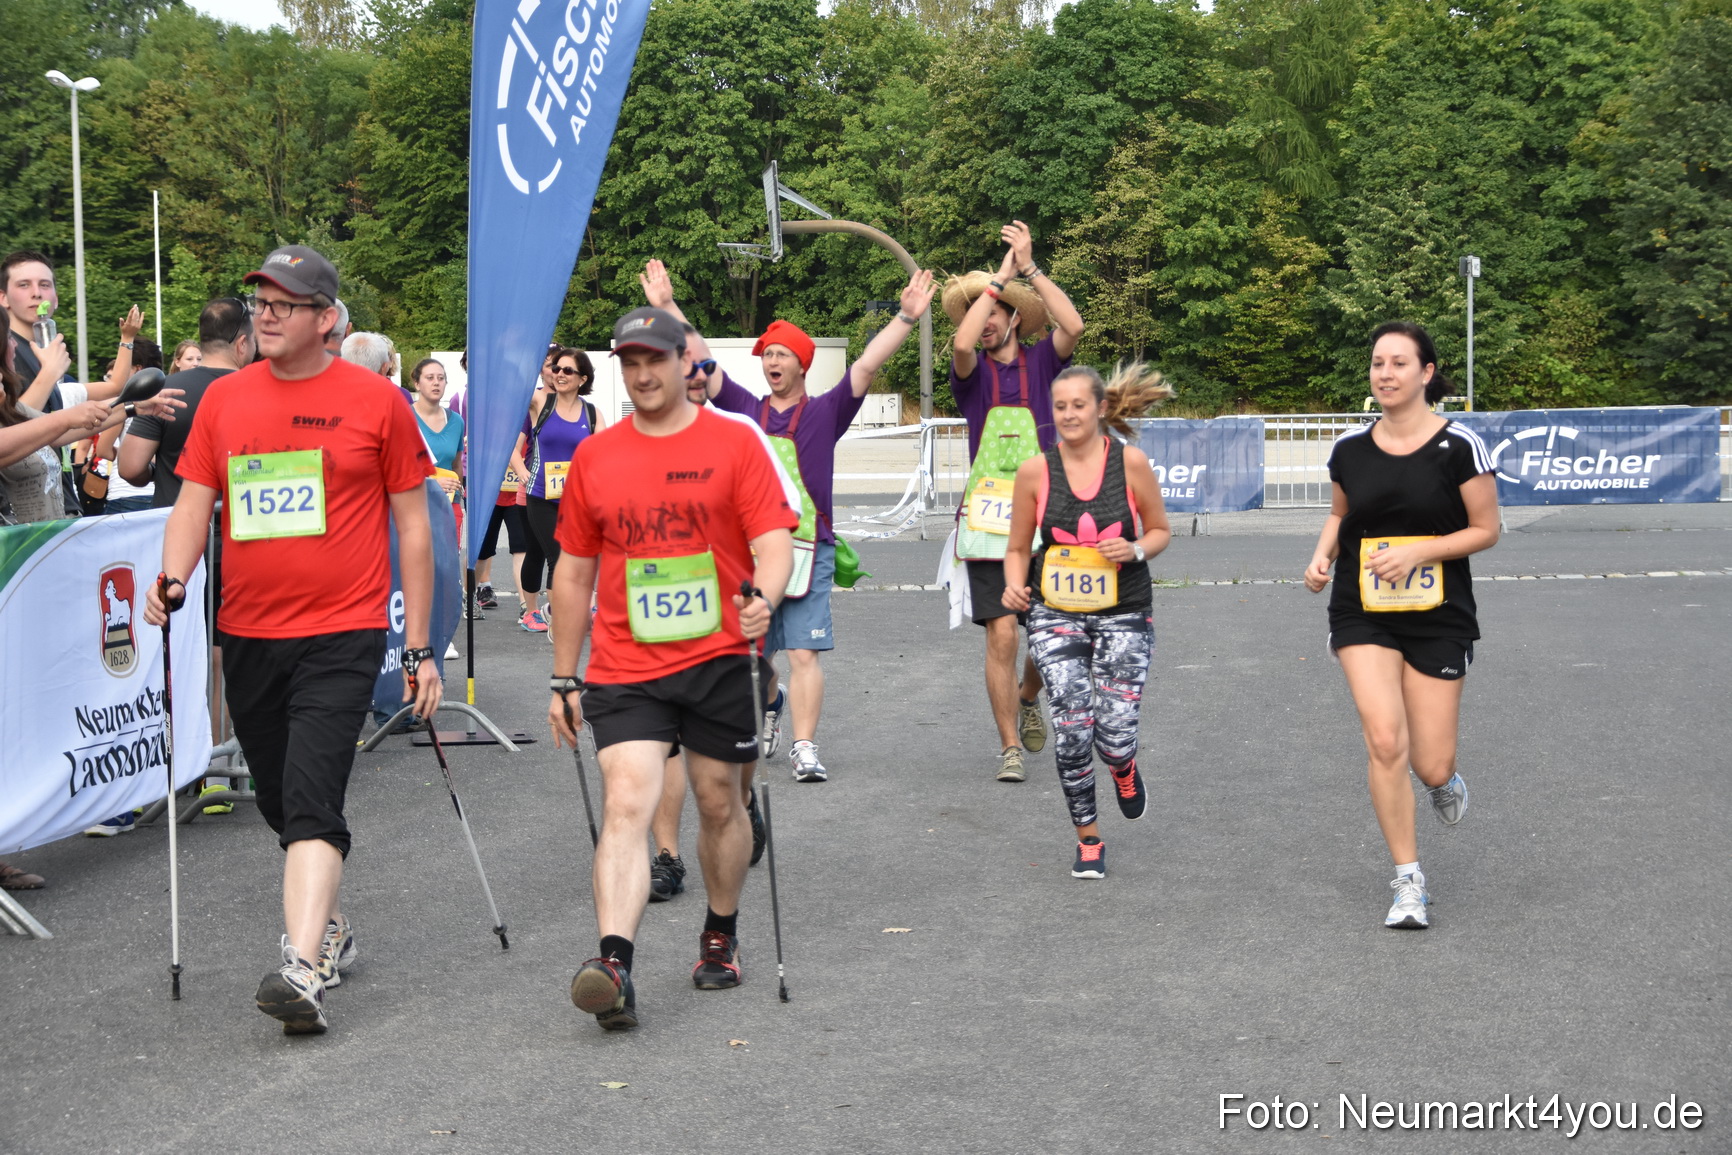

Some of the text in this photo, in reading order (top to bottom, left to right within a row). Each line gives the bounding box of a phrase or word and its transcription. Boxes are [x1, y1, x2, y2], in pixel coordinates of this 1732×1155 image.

[526, 0, 597, 148] Fisc
[569, 0, 622, 145] AUTOMO
[291, 415, 328, 427] swn
[1520, 449, 1661, 476] Fischer
[665, 470, 699, 481] swn
[1533, 477, 1650, 491] AUTOMOBILE
[240, 485, 315, 516] 1522
[1050, 571, 1106, 595] 1181
[637, 586, 708, 619] 1521
[110, 650, 130, 667] 1628
